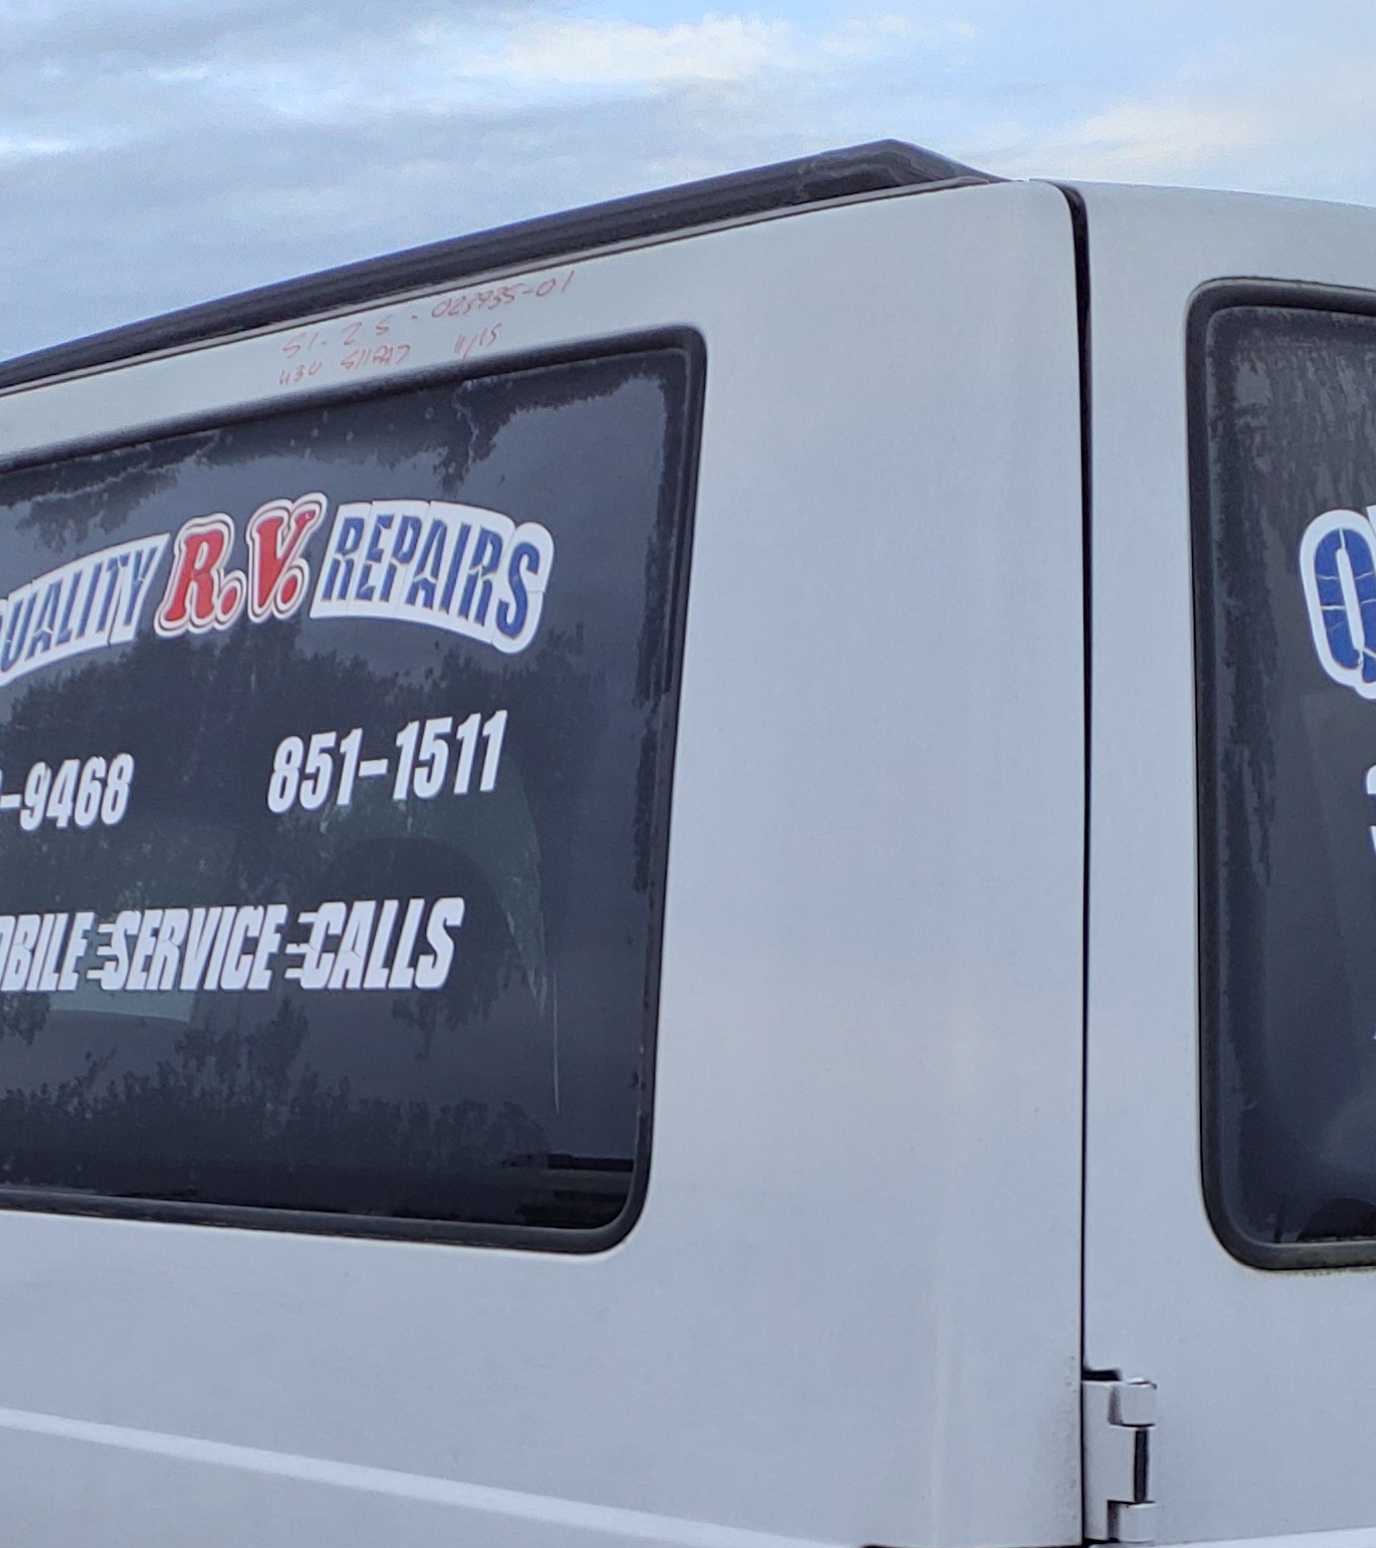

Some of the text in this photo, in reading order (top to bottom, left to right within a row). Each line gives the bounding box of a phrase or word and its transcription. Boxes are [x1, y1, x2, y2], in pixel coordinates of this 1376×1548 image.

[310, 500, 555, 654] REPAIRS
[268, 710, 508, 812] 851-1511
[100, 904, 288, 991] SERVICE
[299, 898, 465, 989] CALLS
